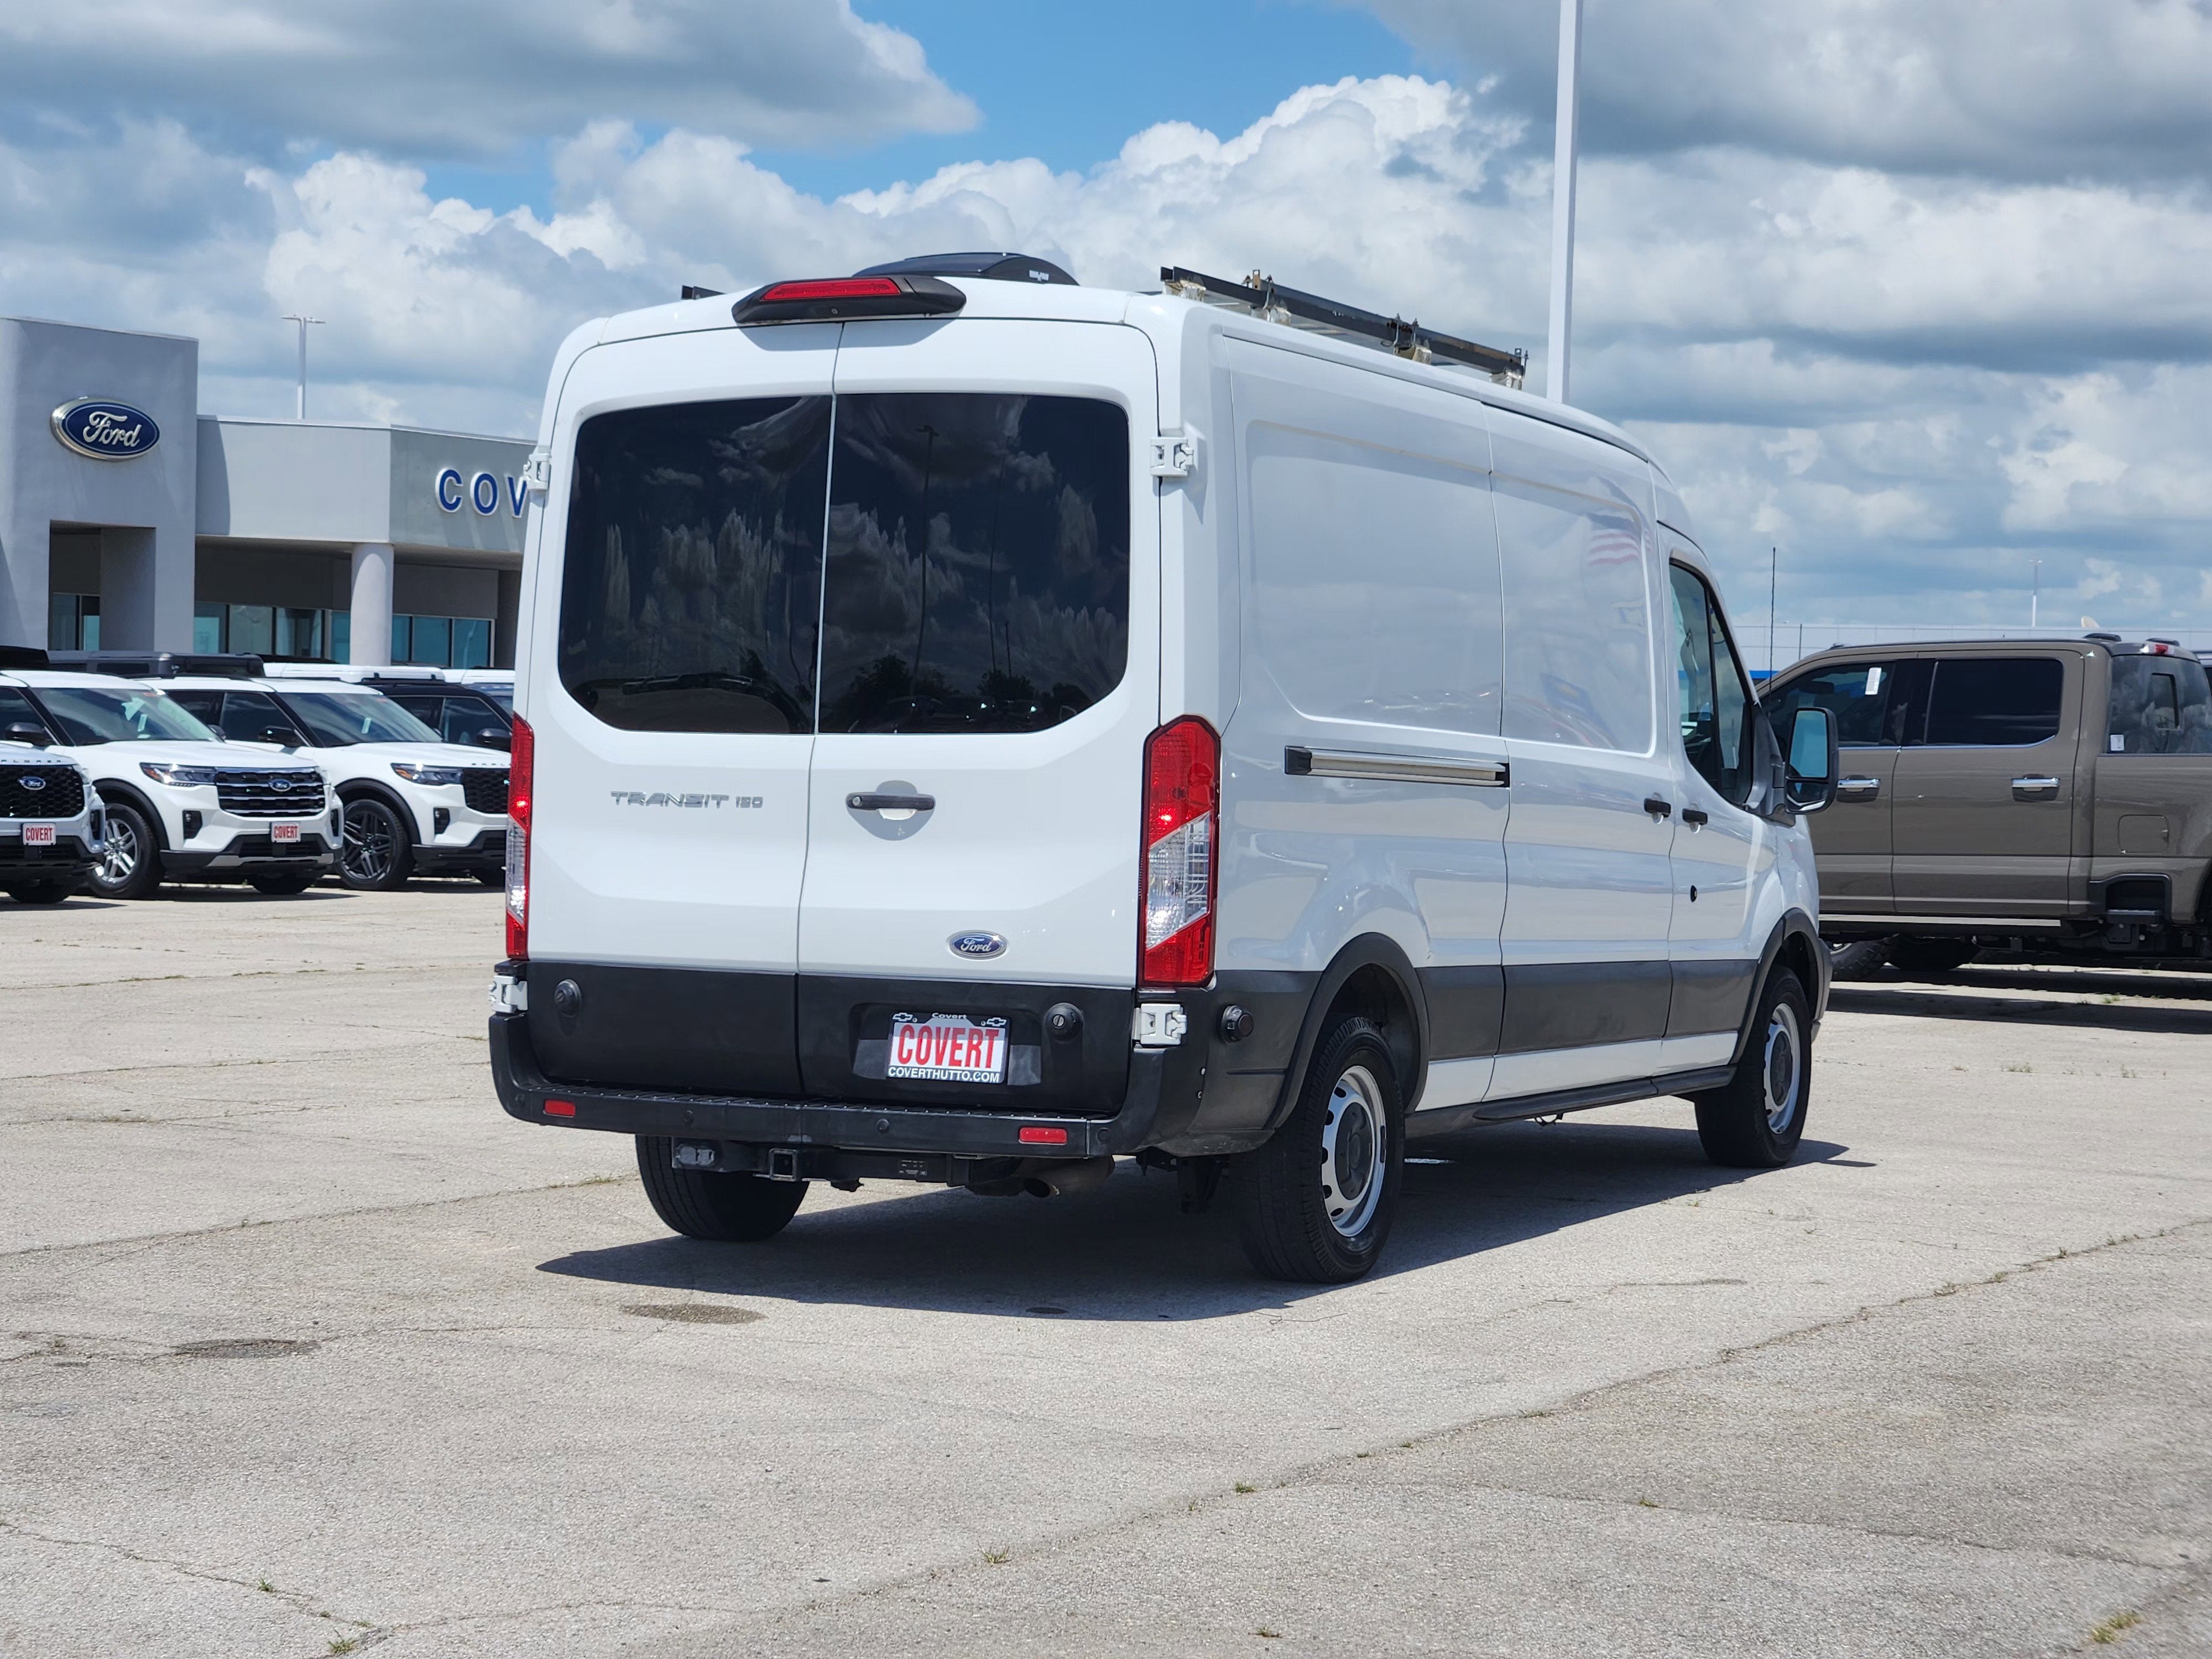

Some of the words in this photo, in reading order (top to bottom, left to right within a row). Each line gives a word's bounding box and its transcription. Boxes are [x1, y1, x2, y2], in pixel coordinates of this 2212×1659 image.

[83, 411, 142, 447] Ford
[611, 791, 729, 809] TRANSIT
[25, 827, 53, 841] COVERT
[274, 826, 298, 838] COVERT
[960, 937, 993, 952] Ford
[897, 1024, 1000, 1069] COVERT
[888, 1067, 1000, 1083] COVERTHUTTO.COM
